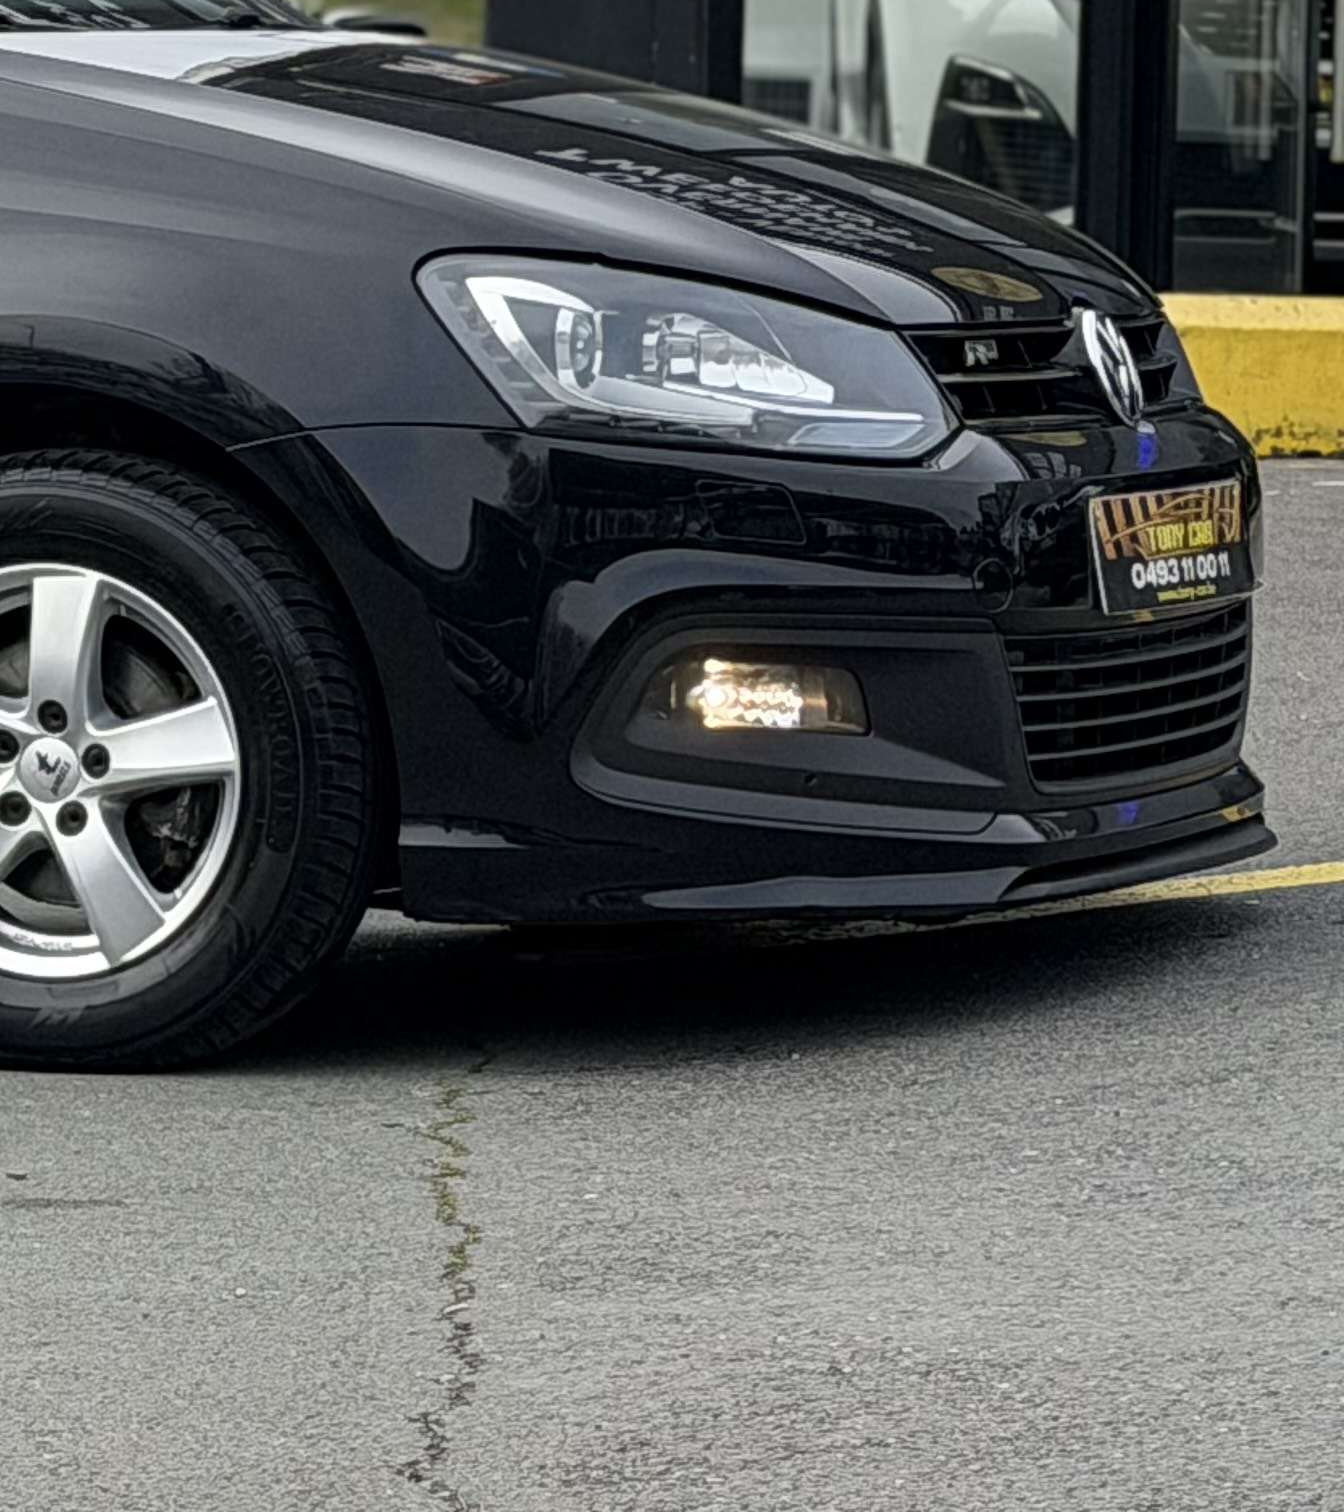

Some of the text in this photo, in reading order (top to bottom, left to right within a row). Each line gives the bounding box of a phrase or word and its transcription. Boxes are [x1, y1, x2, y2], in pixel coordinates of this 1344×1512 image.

[1145, 522, 1185, 552] TONY
[1131, 552, 1231, 589] 0493 11 00 11
